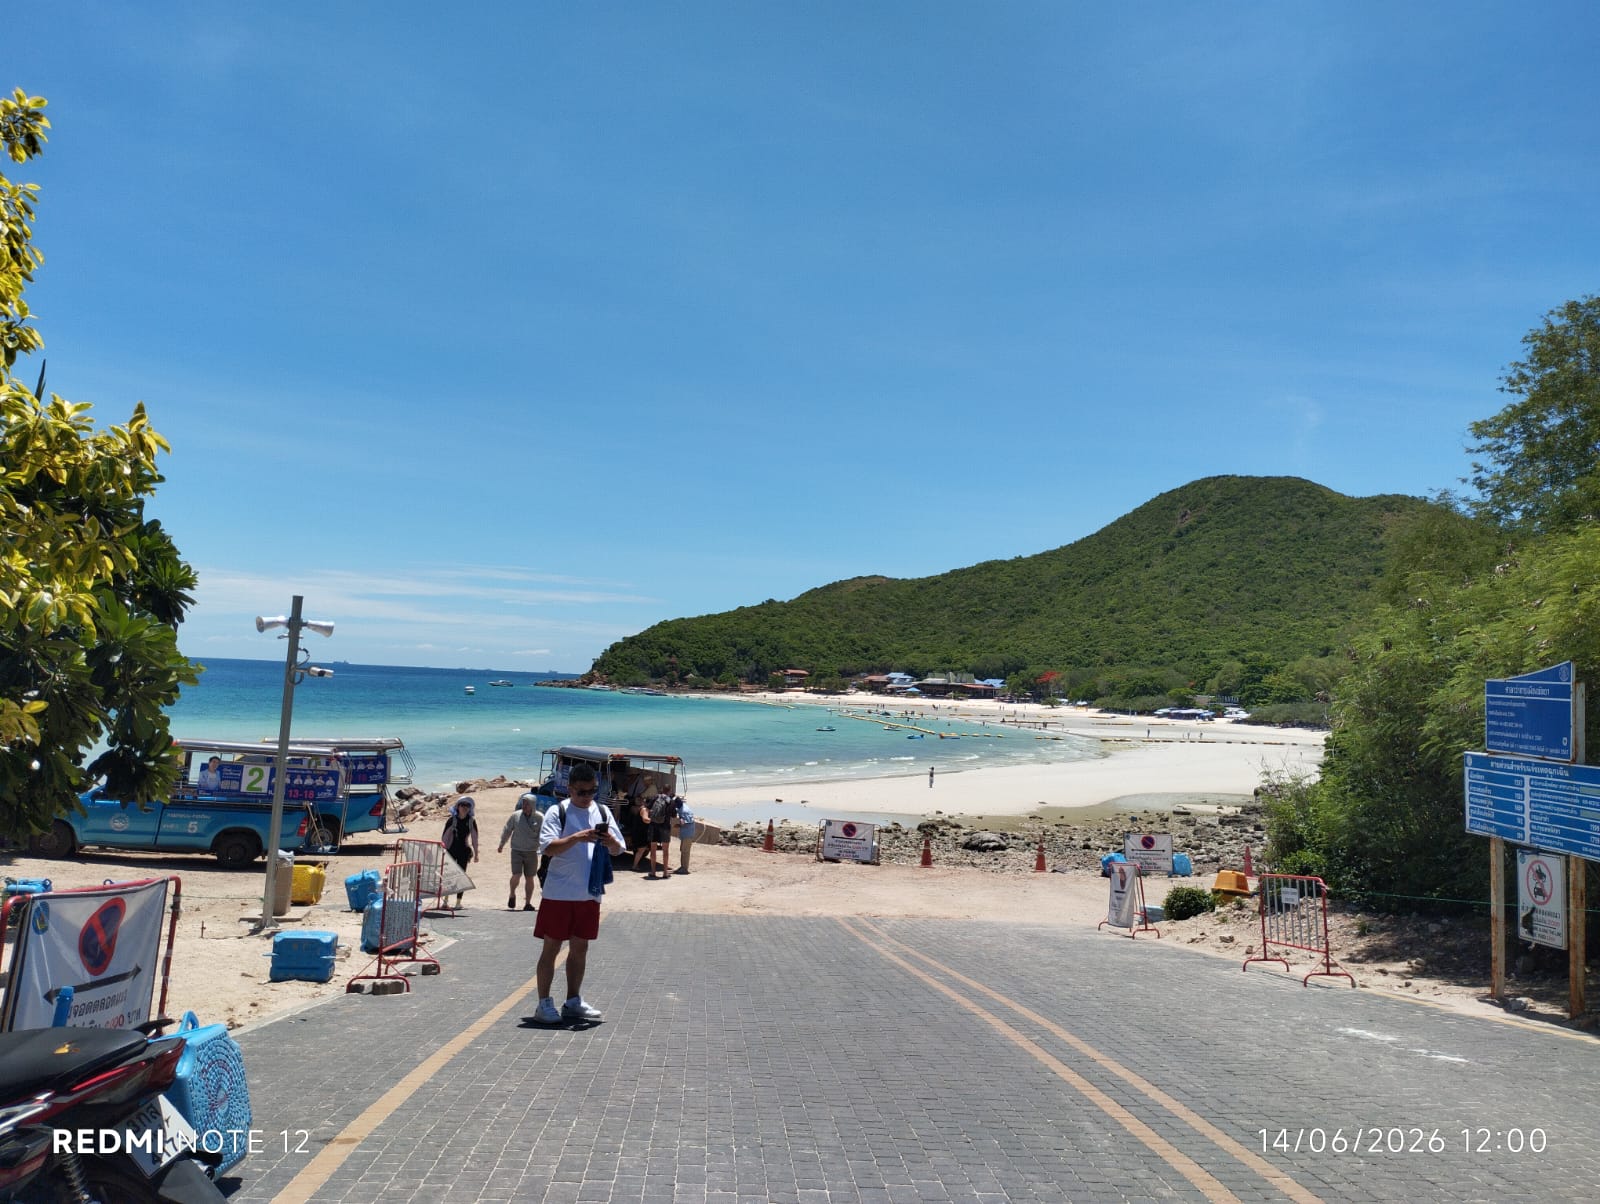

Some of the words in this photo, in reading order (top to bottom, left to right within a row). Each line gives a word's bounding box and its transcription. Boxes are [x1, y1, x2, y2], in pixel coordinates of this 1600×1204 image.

[246, 767, 264, 792] 2
[188, 821, 198, 833] 5
[67, 988, 128, 1019] จอดตลอดแนว
